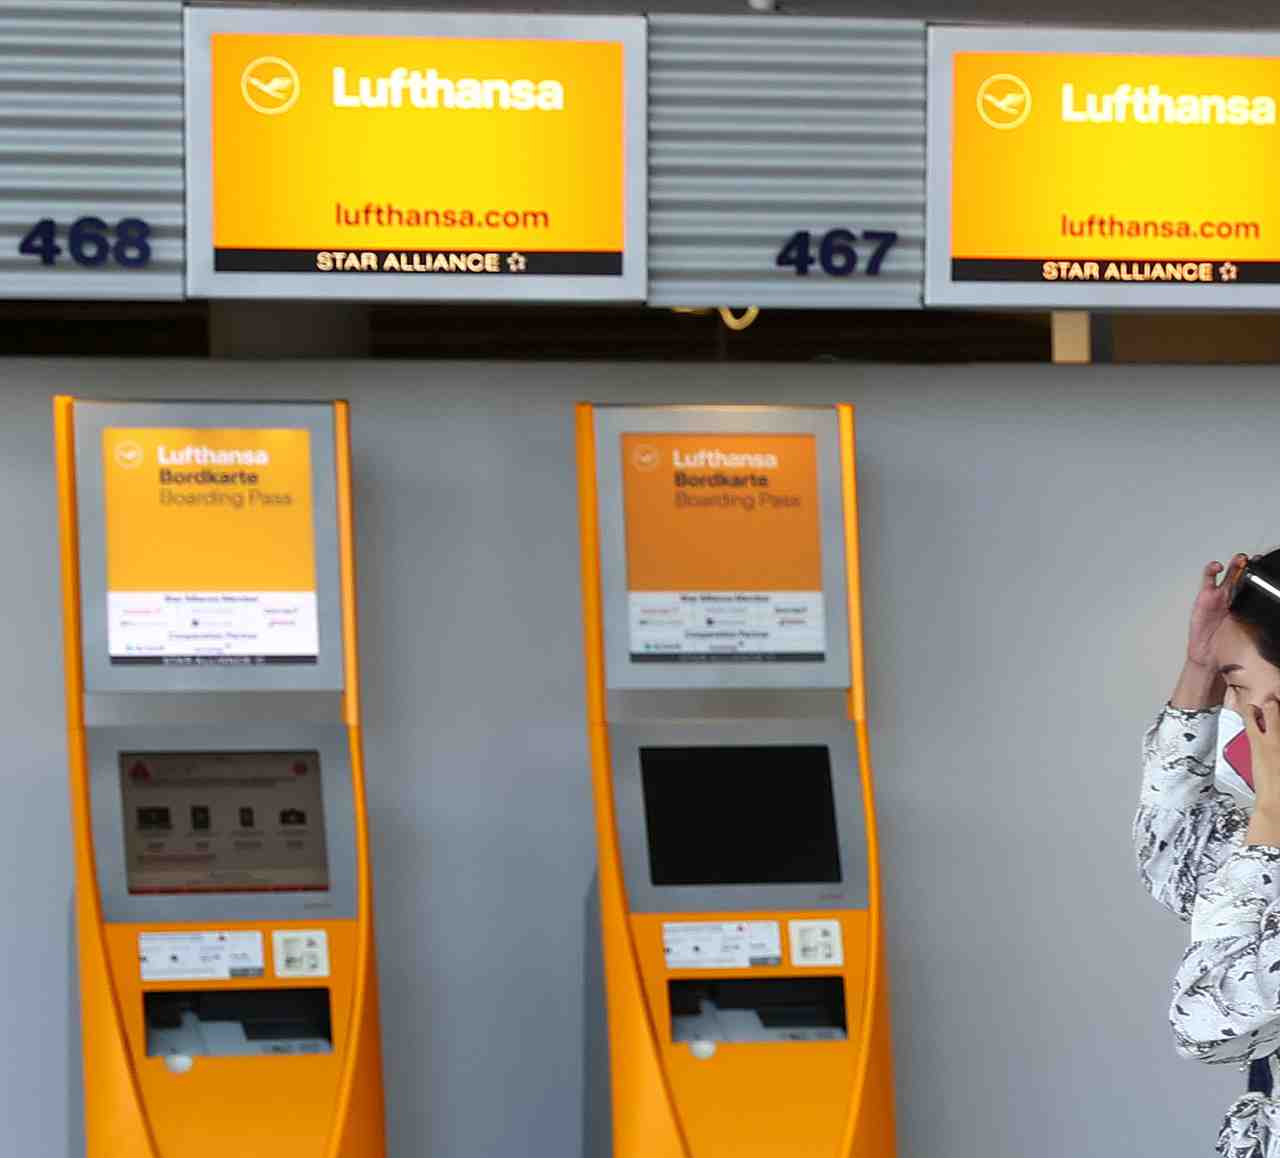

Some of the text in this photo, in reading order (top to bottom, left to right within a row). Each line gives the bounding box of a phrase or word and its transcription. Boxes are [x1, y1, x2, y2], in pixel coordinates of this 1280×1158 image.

[332, 66, 565, 111] Lufthansa
[1060, 82, 1277, 125] Lufthansa
[334, 202, 550, 229] lufthansa.com
[1060, 213, 1261, 240] lufthansa.com
[18, 216, 153, 268] 468
[775, 229, 898, 278] 467
[315, 250, 500, 273] STAR ALLIANCE
[1042, 261, 1213, 282] STAR ALLIANCE
[157, 444, 269, 466] Lufthansa
[672, 448, 778, 468] Lufthansa
[159, 468, 259, 485] Bordkarte
